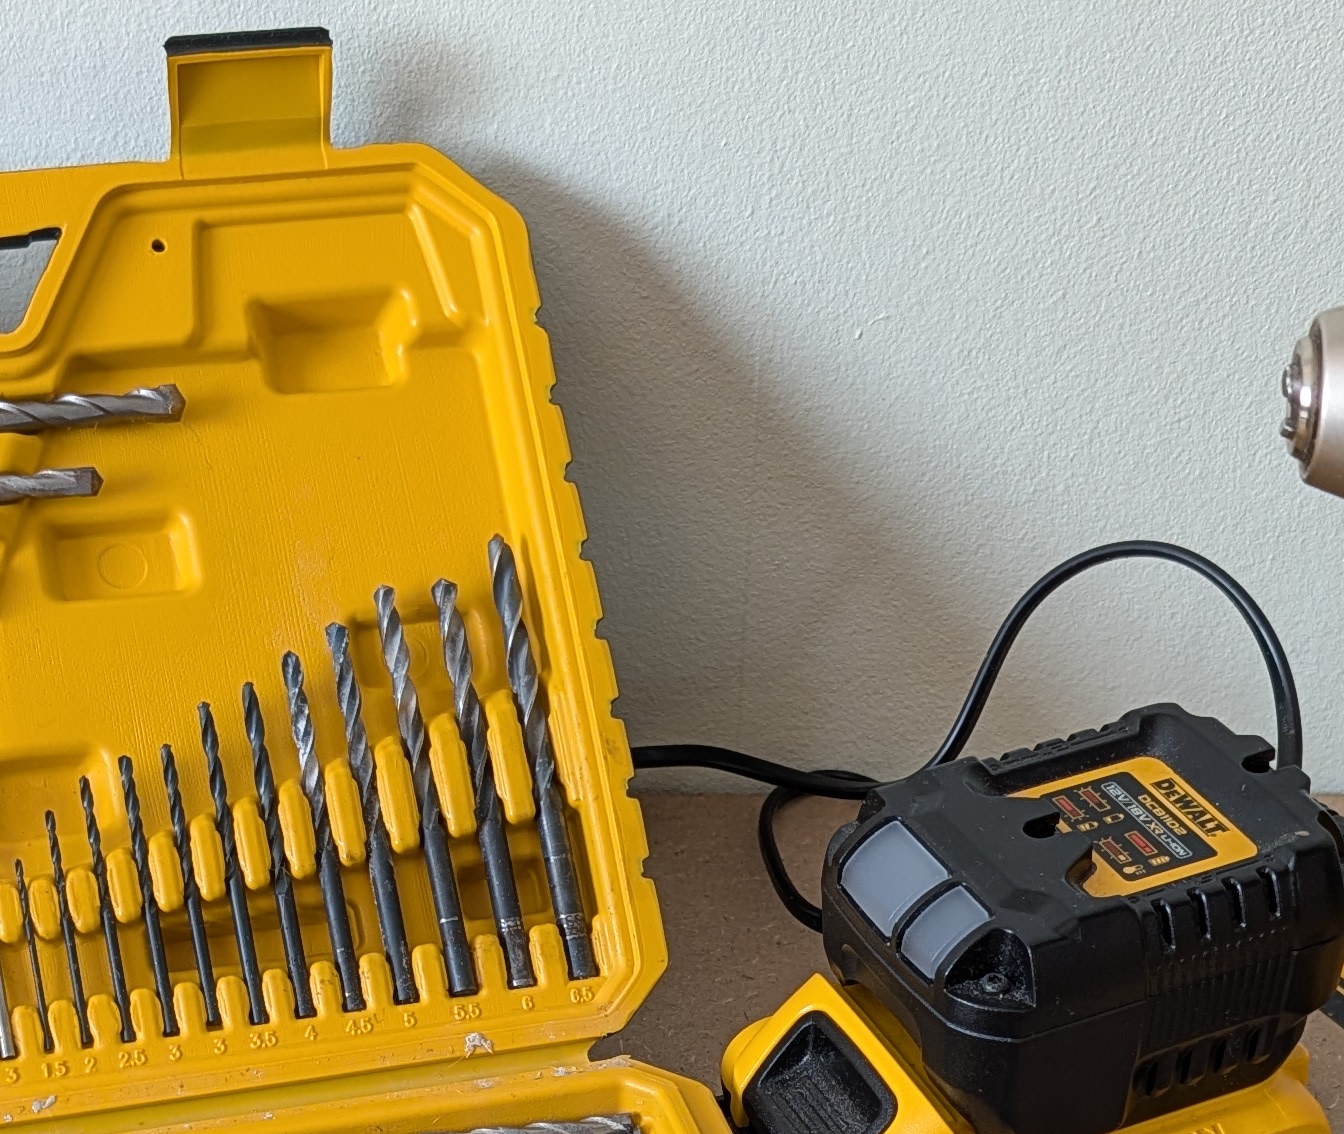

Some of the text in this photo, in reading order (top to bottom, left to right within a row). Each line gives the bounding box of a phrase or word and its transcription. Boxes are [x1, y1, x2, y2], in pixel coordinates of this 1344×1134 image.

[1106, 785, 1151, 821] 12V/18V
[1138, 794, 1187, 836] DCB1102
[1152, 778, 1228, 834] DEWALT
[6, 1068, 20, 1083] 3
[41, 1061, 67, 1078] 1.5
[84, 1057, 98, 1074] 2
[119, 1051, 147, 1068] 2.5
[169, 1045, 182, 1061] 3
[214, 1038, 228, 1054] 3
[249, 1030, 277, 1048] 3.5
[305, 1025, 318, 1041] 4
[345, 1018, 373, 1035] 4.5
[403, 1012, 417, 1029] 5
[454, 1003, 482, 1021] 5.5
[522, 995, 535, 1011] 6
[570, 987, 594, 1004] 6.5
